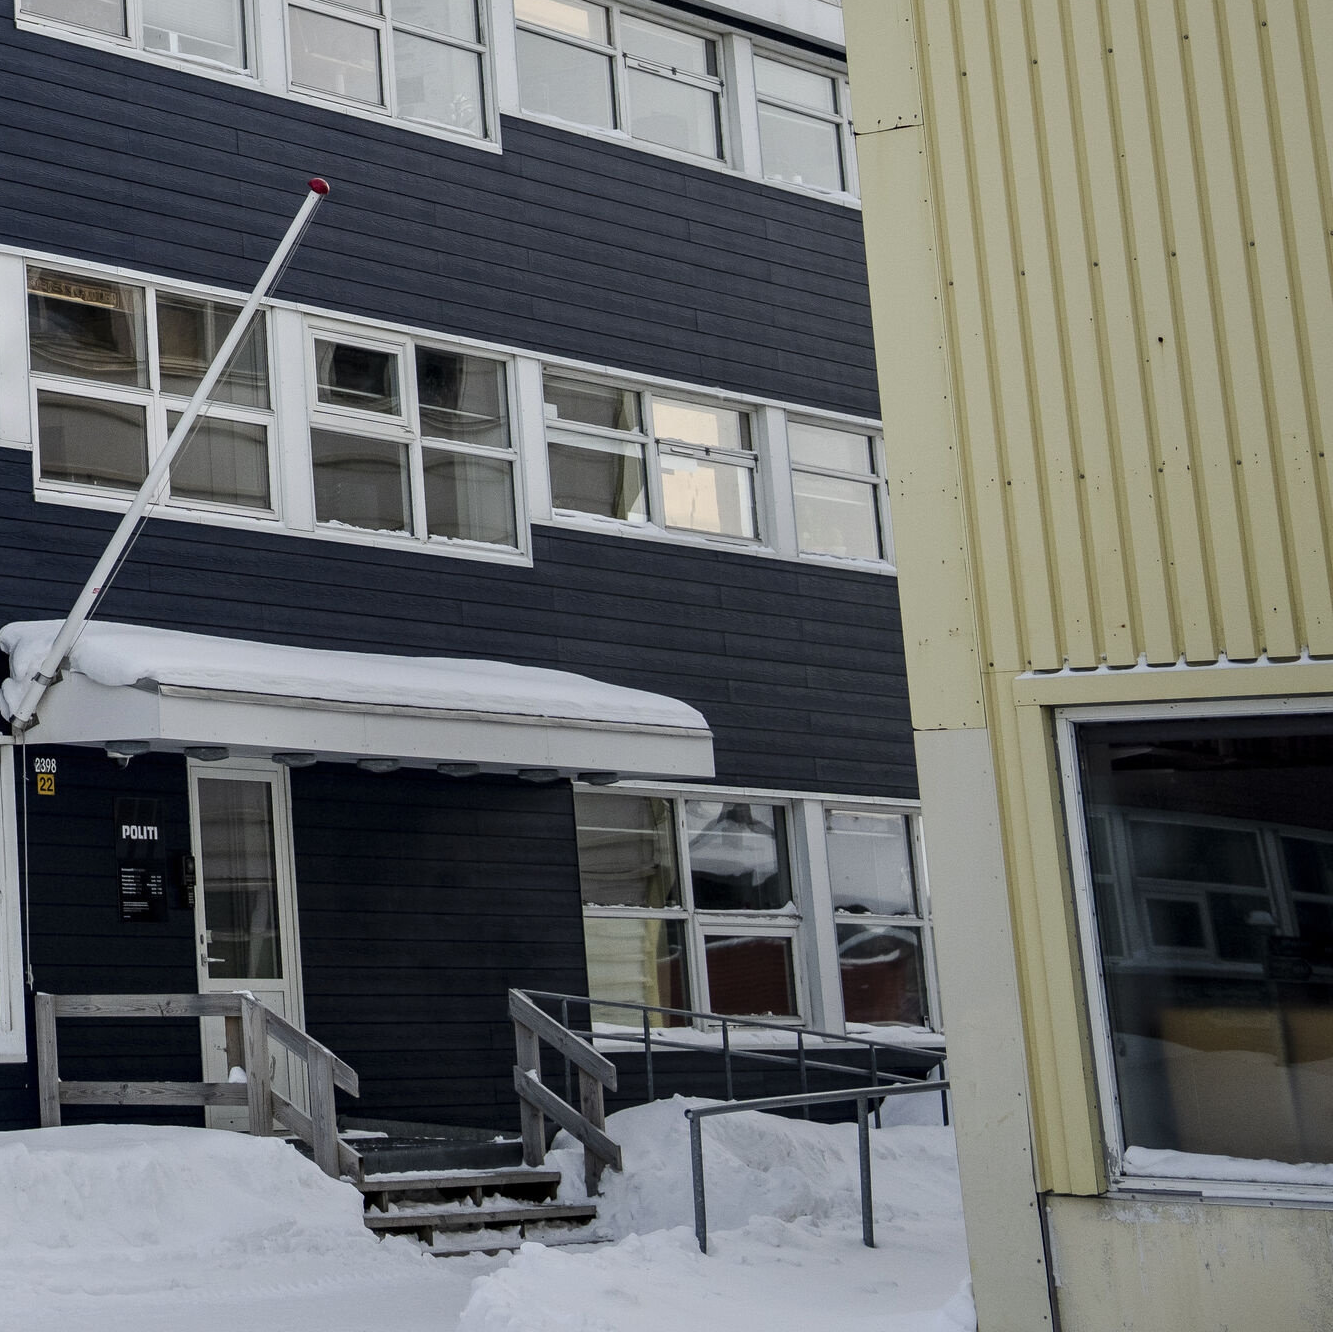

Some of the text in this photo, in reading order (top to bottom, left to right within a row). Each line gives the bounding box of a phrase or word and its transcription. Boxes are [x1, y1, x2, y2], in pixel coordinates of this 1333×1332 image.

[34, 757, 57, 773] 2398
[39, 776, 54, 792] 22
[121, 825, 158, 840] POLITI
